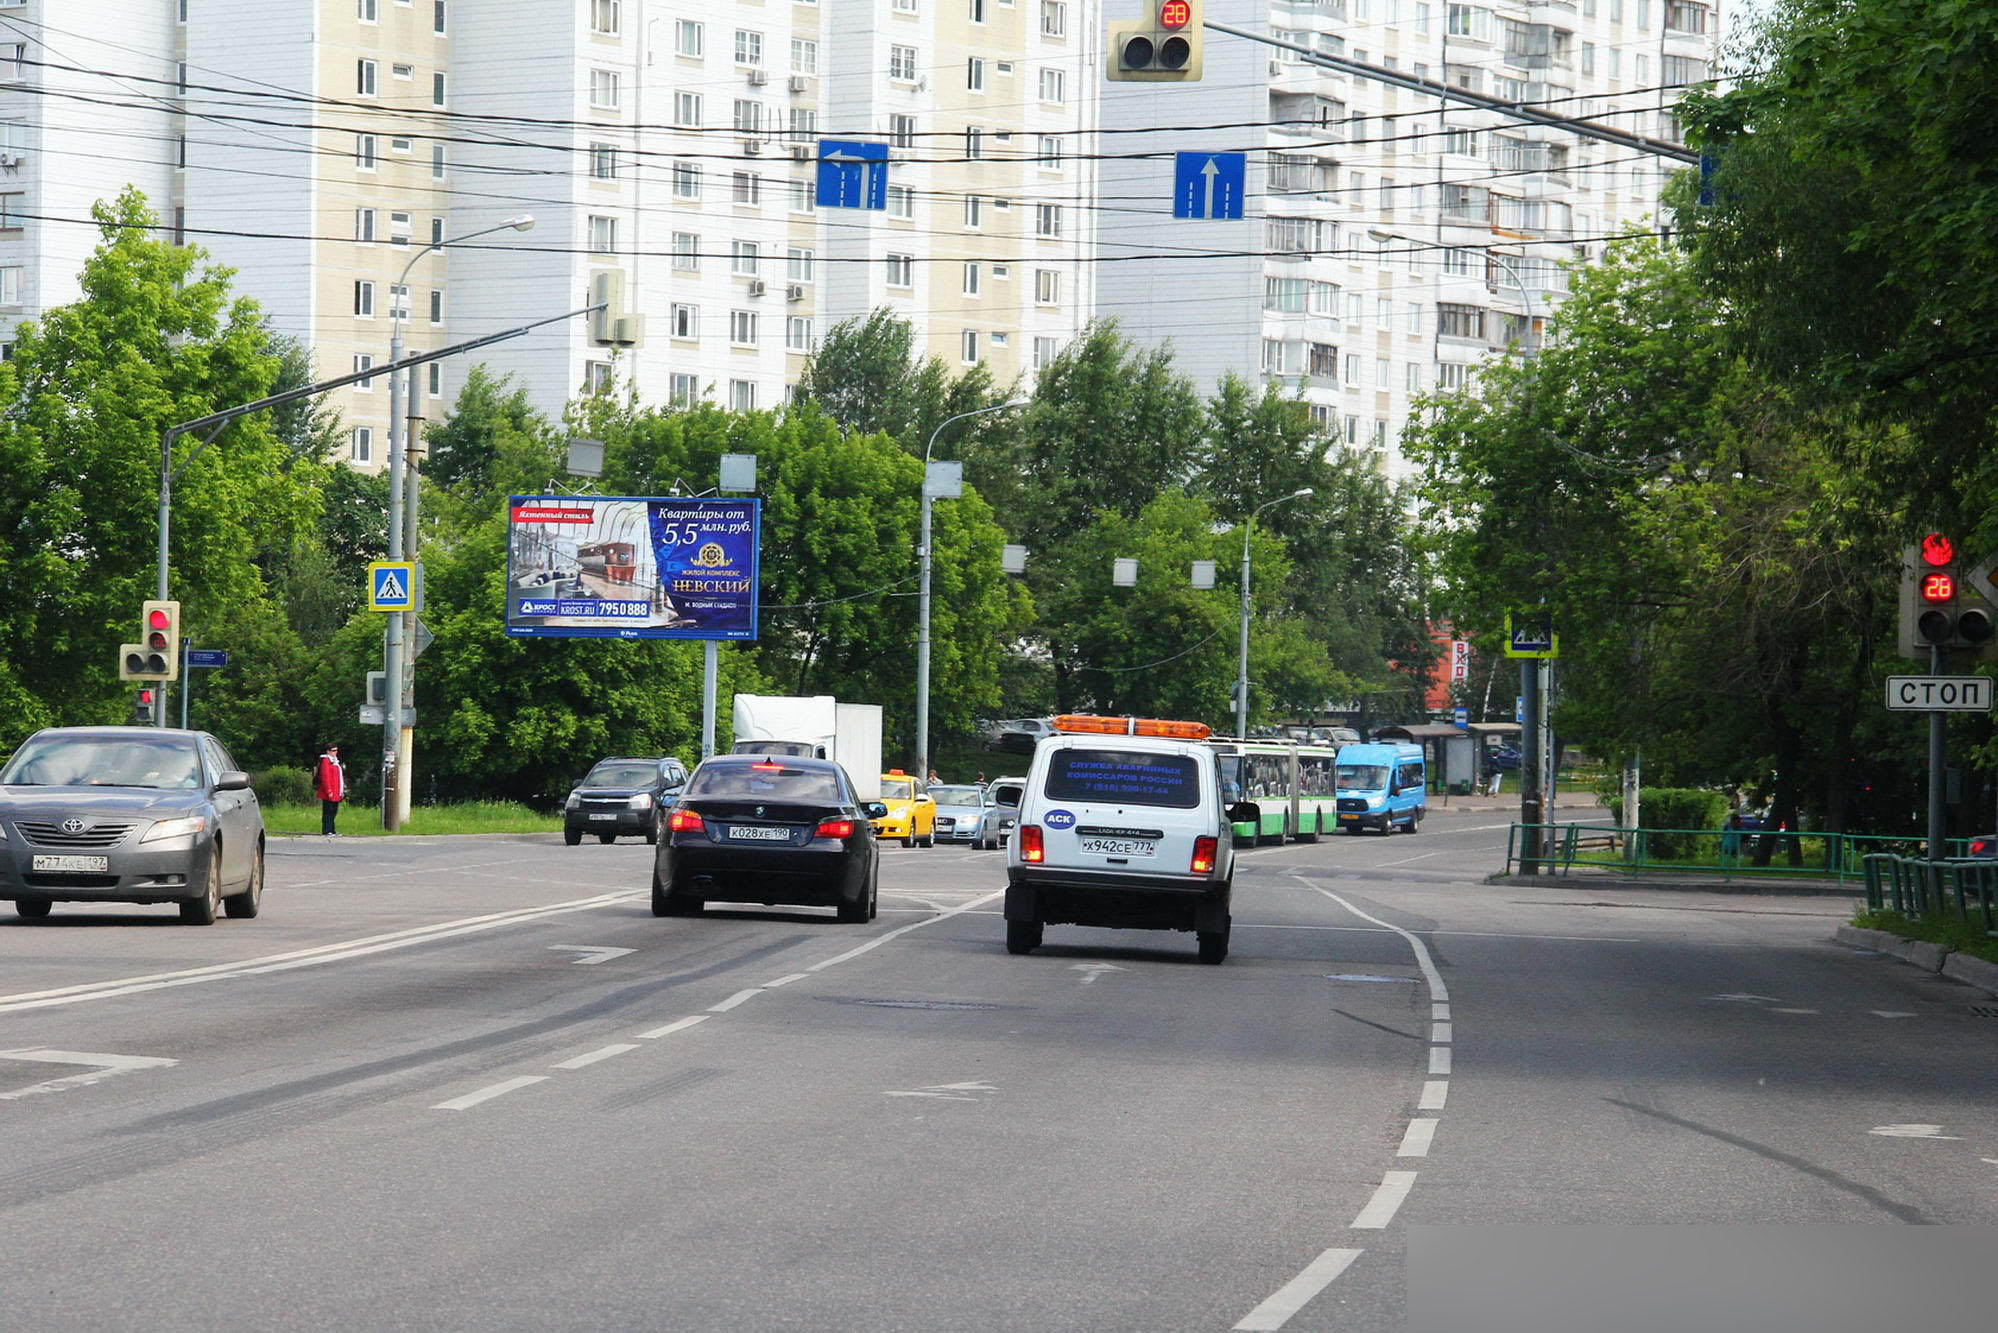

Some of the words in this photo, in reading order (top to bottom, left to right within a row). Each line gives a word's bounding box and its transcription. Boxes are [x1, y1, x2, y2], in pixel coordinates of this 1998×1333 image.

[1164, 4, 1186, 23] 28
[658, 505, 724, 521] Квартиры
[726, 510, 745, 520] от
[662, 523, 699, 547] 5,5
[699, 523, 727, 532] млн.
[728, 520, 752, 534] руб.
[672, 577, 752, 593] НЕВСКИЙ
[560, 605, 595, 615] KROST.RU
[1900, 682, 1978, 704] СТОП
[1140, 775, 1183, 785] РОССИИ
[1047, 814, 1071, 825] АСК
